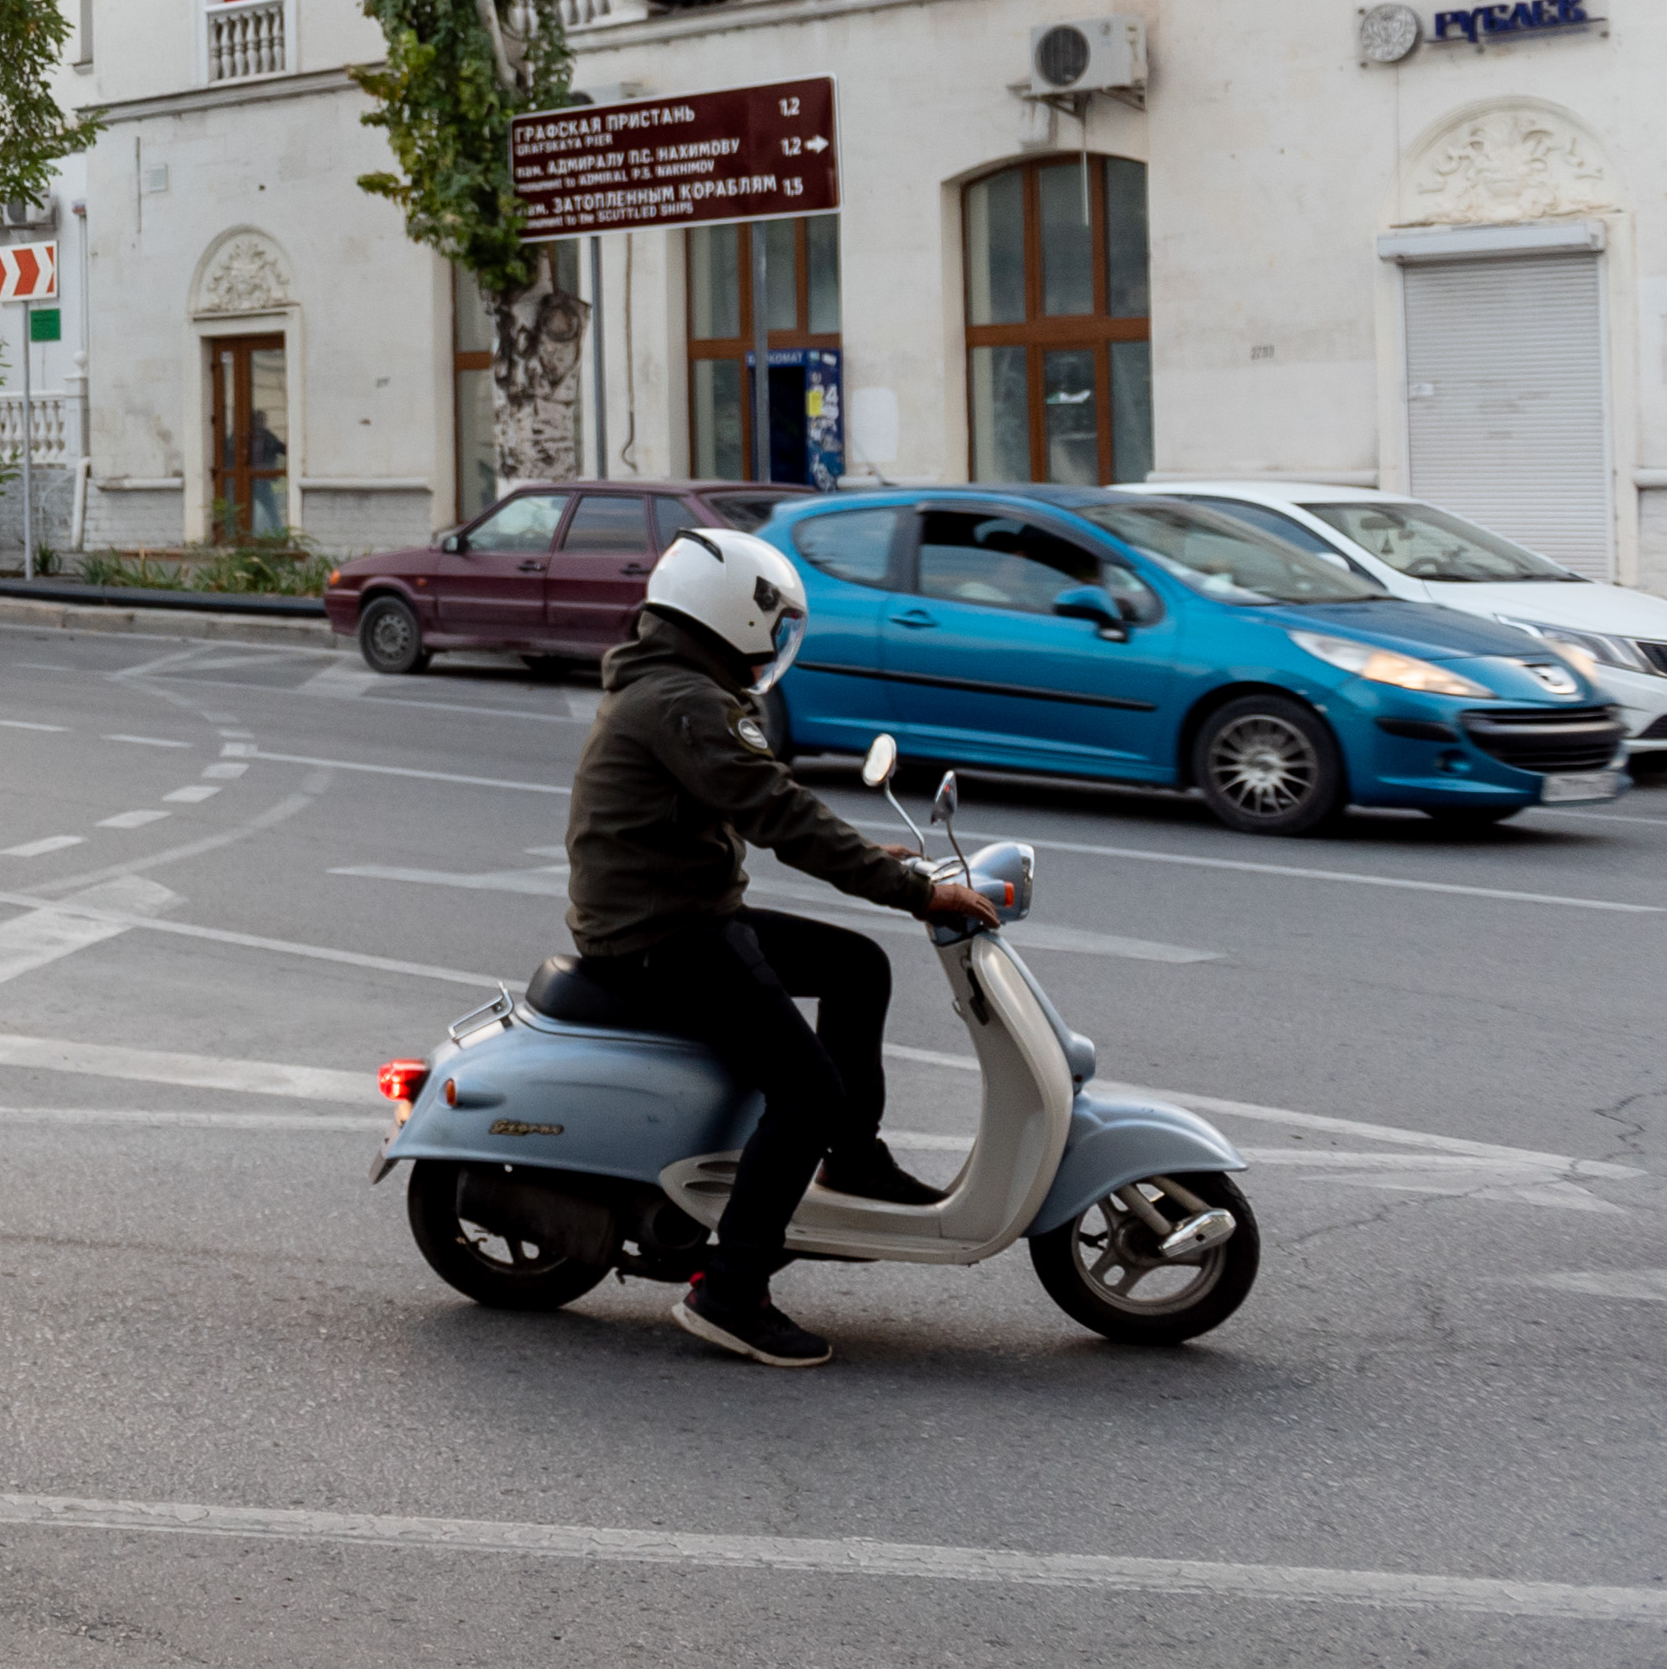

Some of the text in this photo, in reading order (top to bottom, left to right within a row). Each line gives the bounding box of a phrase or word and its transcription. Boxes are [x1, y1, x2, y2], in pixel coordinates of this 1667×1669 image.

[515, 96, 801, 144] ГРАФСКАЯ ПРИСТАНЬ 1,2
[585, 132, 614, 148] PIER
[547, 152, 625, 176] АДМИРАЛУ
[628, 148, 654, 164] П.С.
[657, 137, 740, 162] НАХИМОВУ
[781, 136, 802, 157] 1,2
[578, 169, 629, 186] ADMIRAL
[631, 165, 653, 180] P.S.
[656, 159, 715, 178] NAKHIMOV
[552, 185, 675, 214] ЗАТОПЛЕННЫМ
[678, 174, 778, 200] КОРАБЛЯМ
[783, 177, 804, 197] 1,5
[597, 205, 658, 223] SCUTTLED
[660, 200, 694, 217] SHIPS
[748, 352, 803, 365] БКОМАТ
